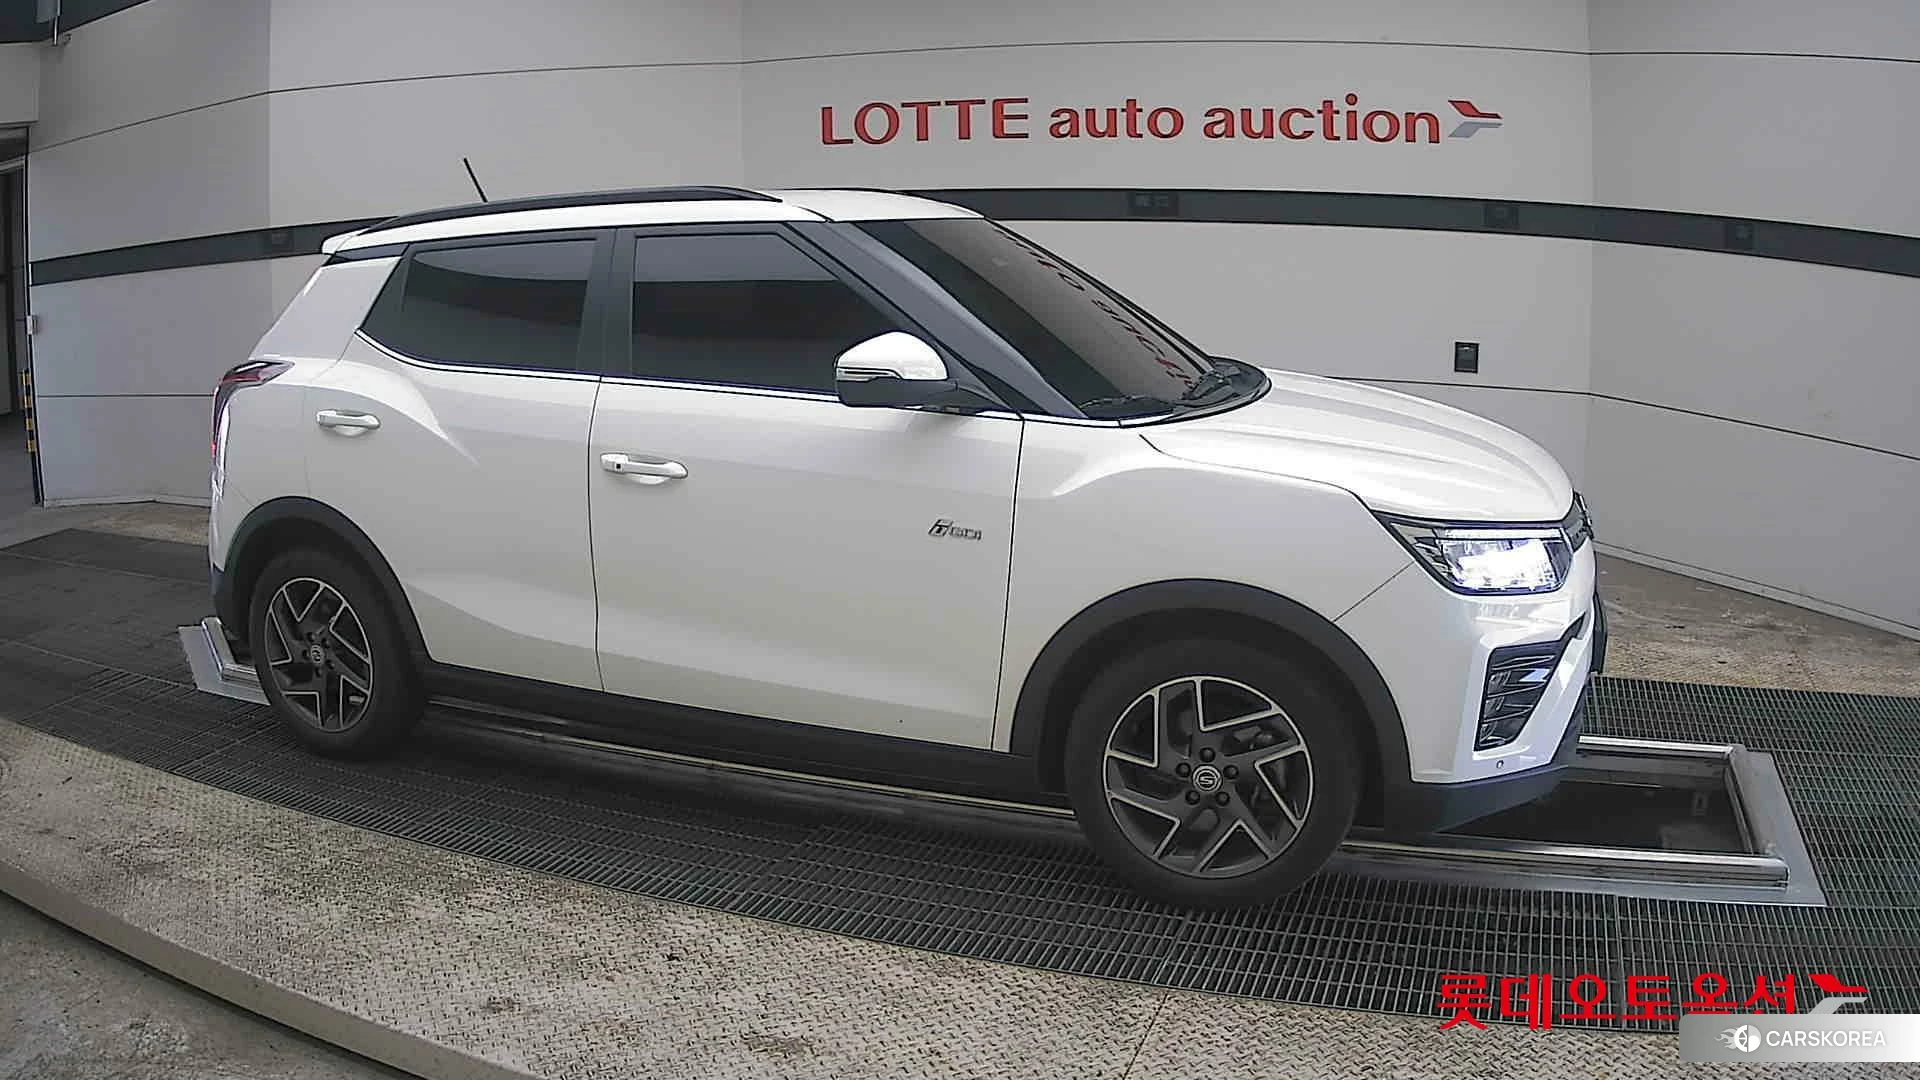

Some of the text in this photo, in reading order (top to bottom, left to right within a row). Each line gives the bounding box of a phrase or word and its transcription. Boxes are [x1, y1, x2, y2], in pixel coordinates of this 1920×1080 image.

[821, 94, 1442, 146] LOTTE auto auction
